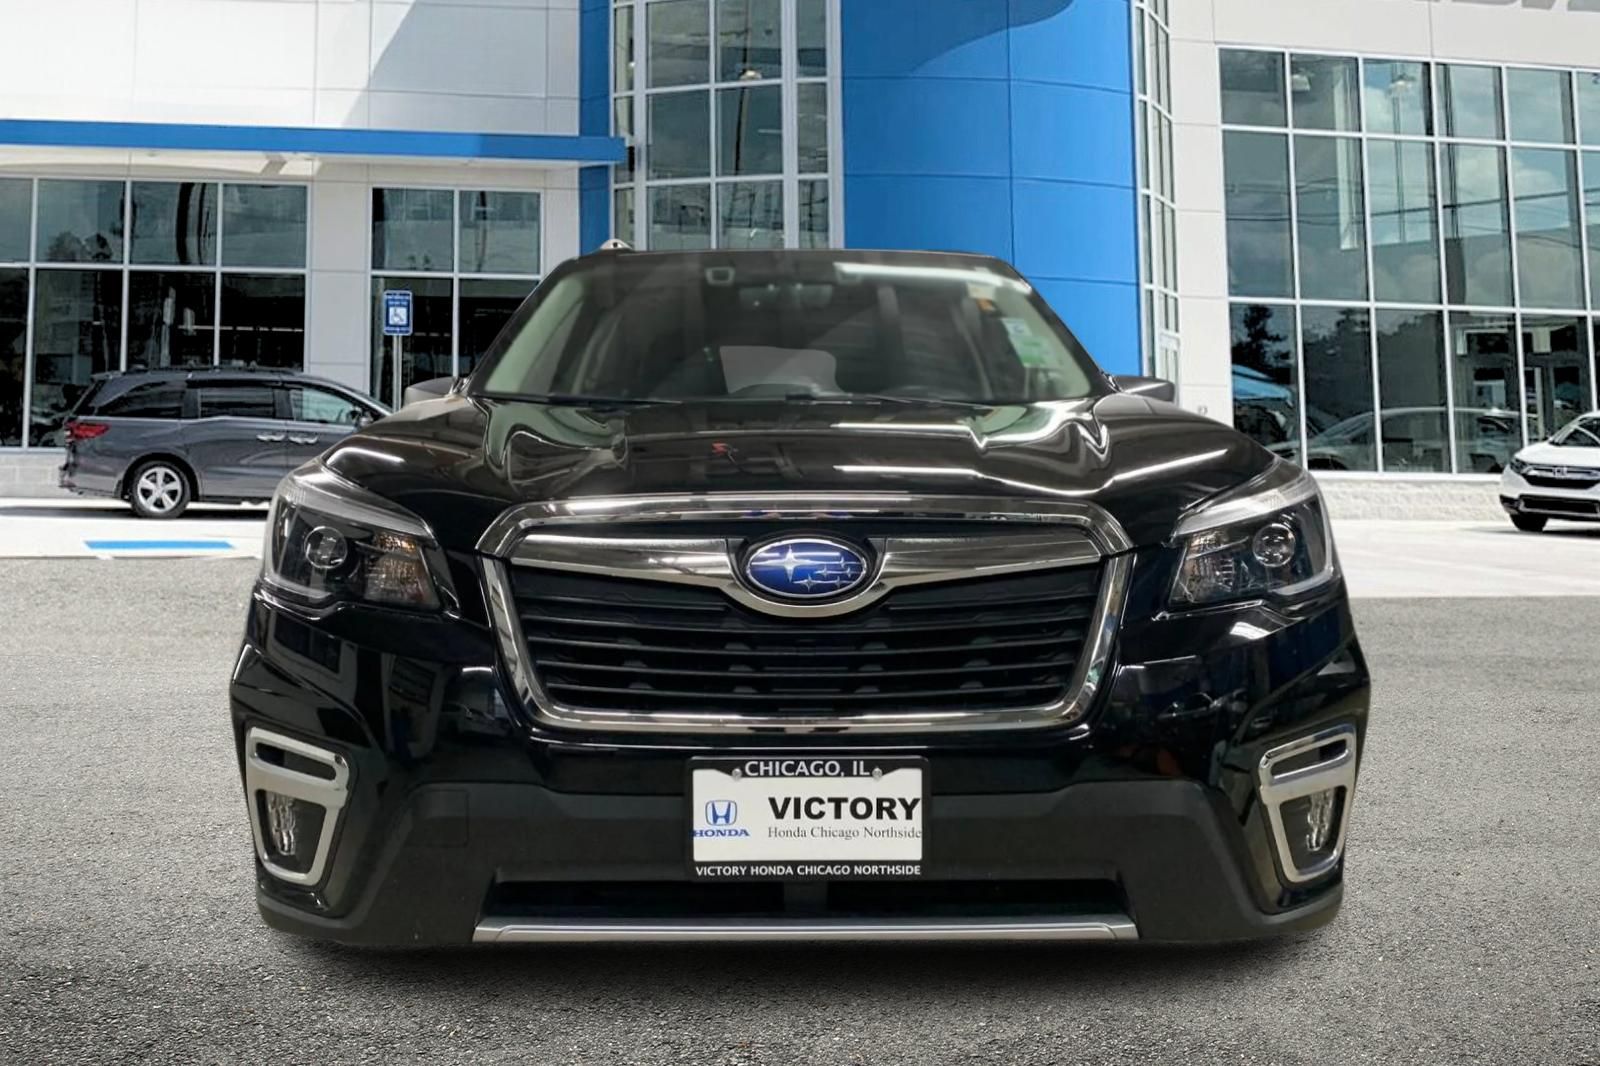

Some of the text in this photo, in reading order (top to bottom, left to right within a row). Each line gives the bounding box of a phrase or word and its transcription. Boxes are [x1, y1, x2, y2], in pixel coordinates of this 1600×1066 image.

[745, 760, 871, 777] CHICAGO, IL
[768, 797, 922, 820] VICTORY
[693, 828, 750, 837] HONDA
[768, 826, 922, 841] Honda Chicago Northside
[696, 865, 921, 876] VICTORY HONDA CHICAGO NORTHSIDE
